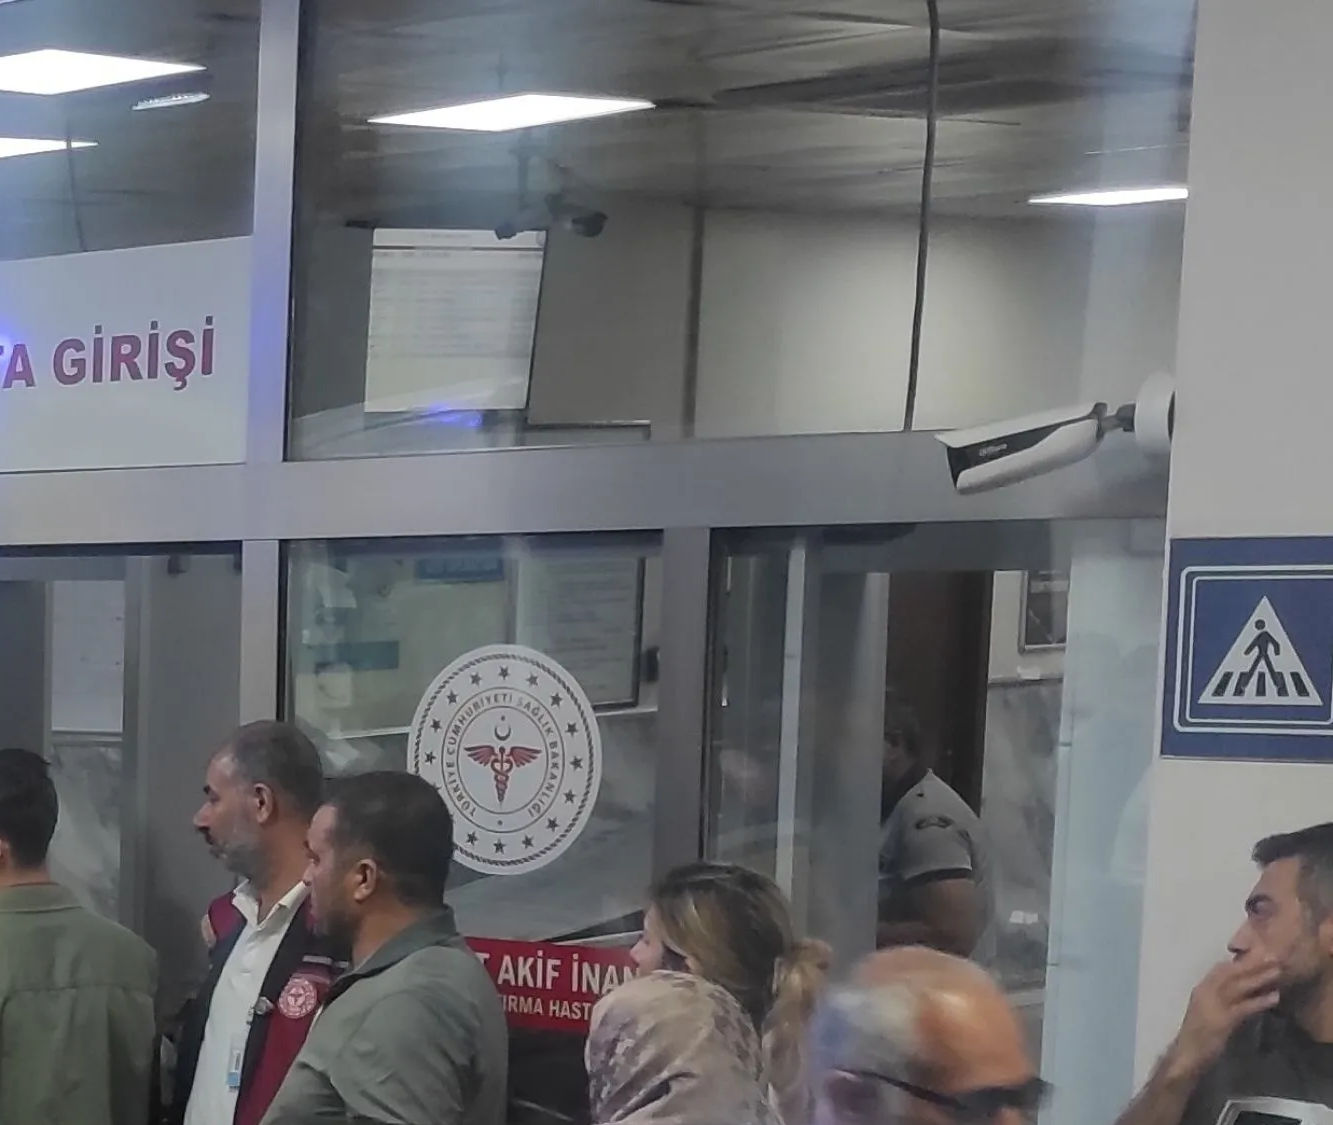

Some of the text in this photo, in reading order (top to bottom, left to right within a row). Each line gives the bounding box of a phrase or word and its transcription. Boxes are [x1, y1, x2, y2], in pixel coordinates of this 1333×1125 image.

[52, 315, 215, 391] GİRİŞİ
[445, 692, 560, 818] TÜRKİYE CUMHURİYETİ SAĞLIK BAKANLIĞI
[497, 950, 562, 990] AKİF
[548, 999, 592, 1021] HAST
